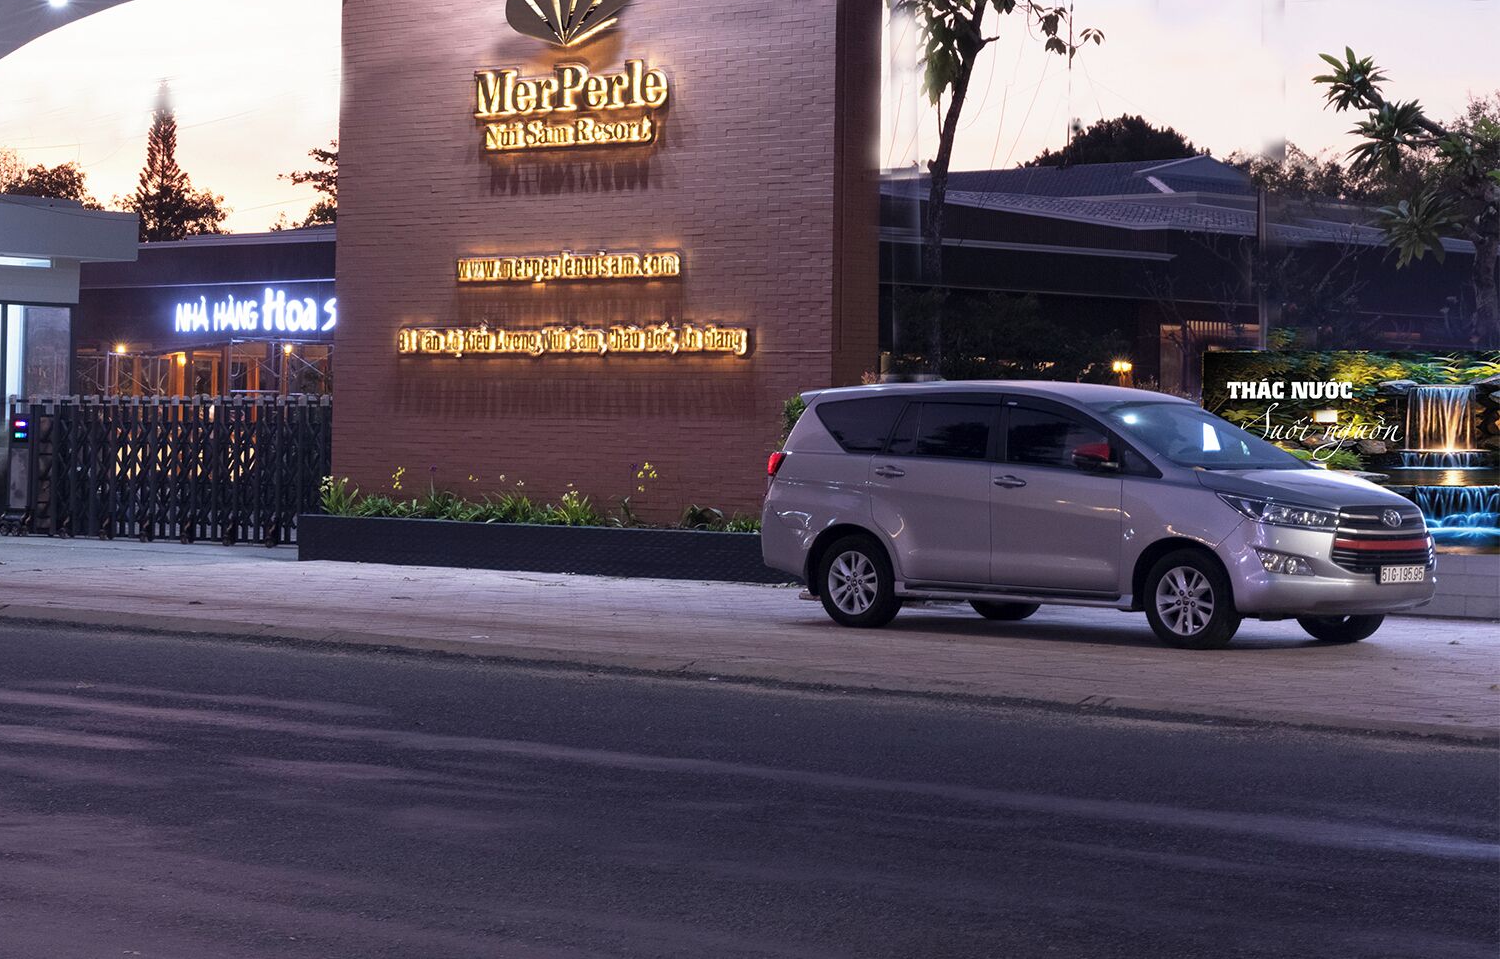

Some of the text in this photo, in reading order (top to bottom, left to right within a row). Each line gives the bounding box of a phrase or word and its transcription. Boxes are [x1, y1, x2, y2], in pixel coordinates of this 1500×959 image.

[474, 59, 668, 119] MerPerle
[526, 119, 574, 144] Sam
[575, 116, 654, 143] Resort
[456, 249, 681, 283] www.merperlenuisam.com
[175, 295, 209, 332] NHÀ
[213, 293, 259, 332] HÀNG
[263, 287, 317, 332] Hoa
[1226, 378, 1353, 400] THÁC NƯỚC
[1240, 402, 1404, 461] Suối nguồn
